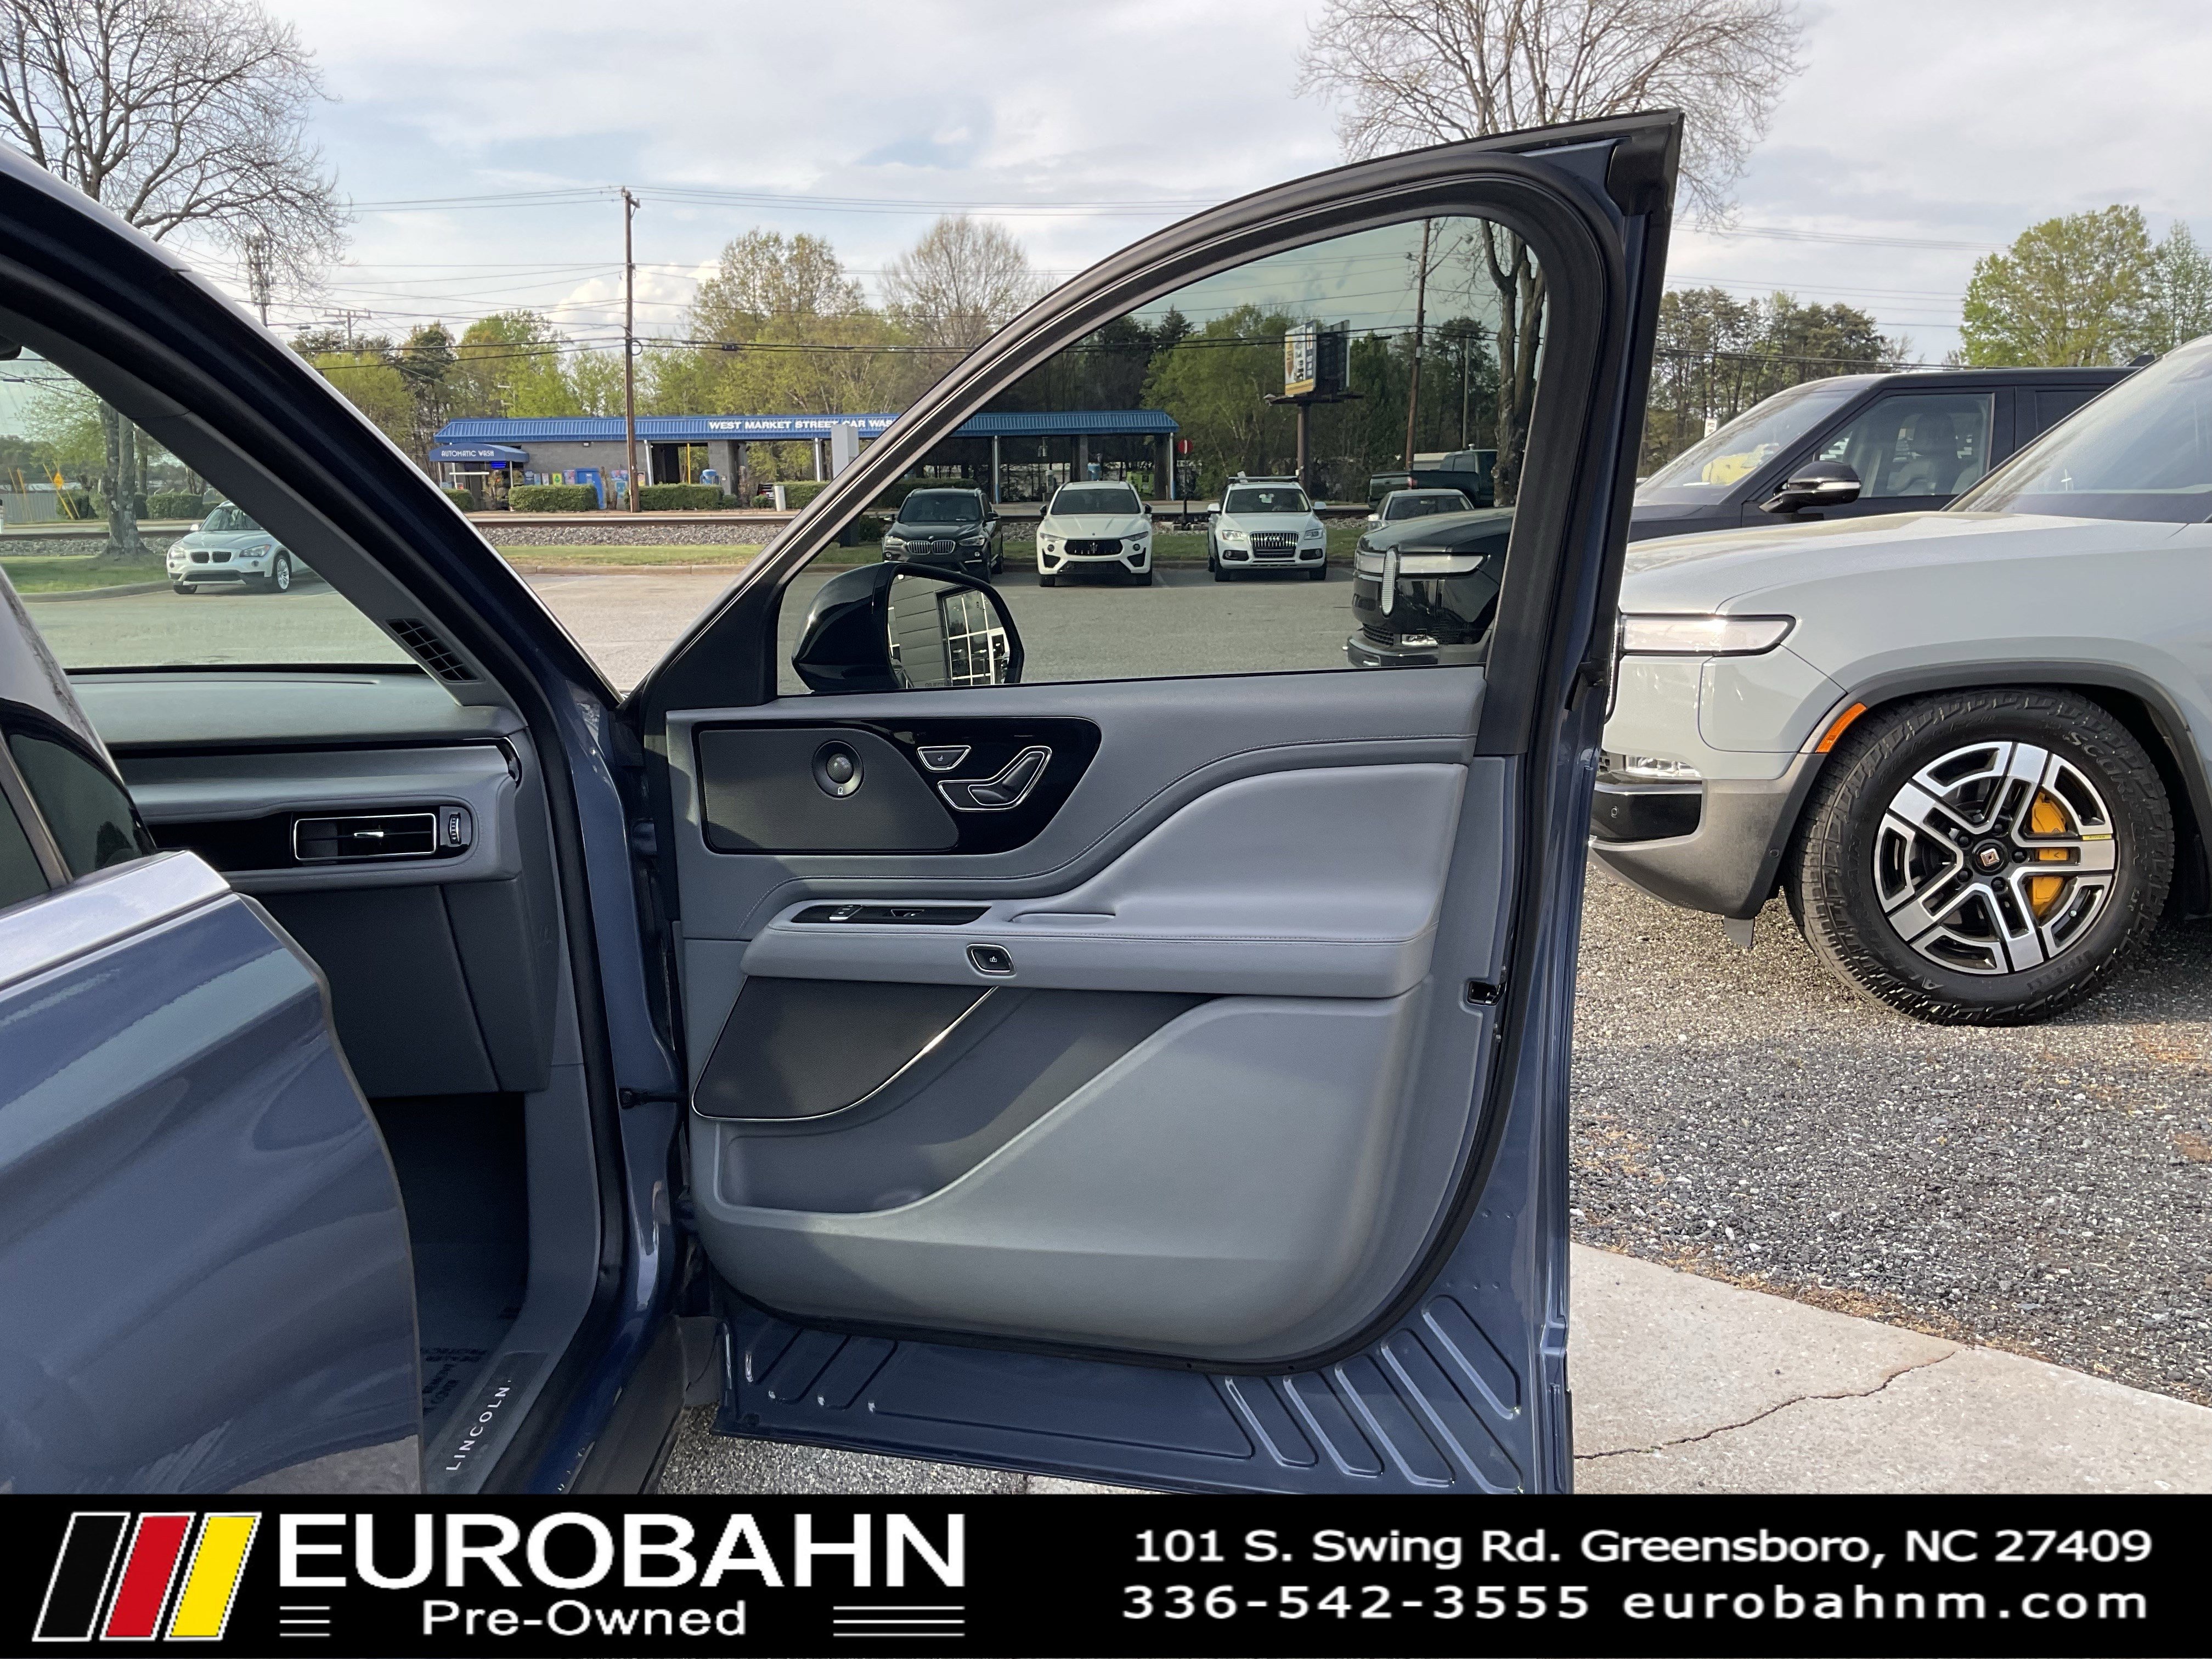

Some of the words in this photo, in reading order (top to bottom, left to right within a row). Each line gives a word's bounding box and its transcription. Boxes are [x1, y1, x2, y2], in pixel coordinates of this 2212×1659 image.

[744, 421, 792, 429] MARKET
[842, 420, 866, 428] CAR
[869, 419, 896, 427] WAS
[445, 1387, 510, 1470] LINCOLN
